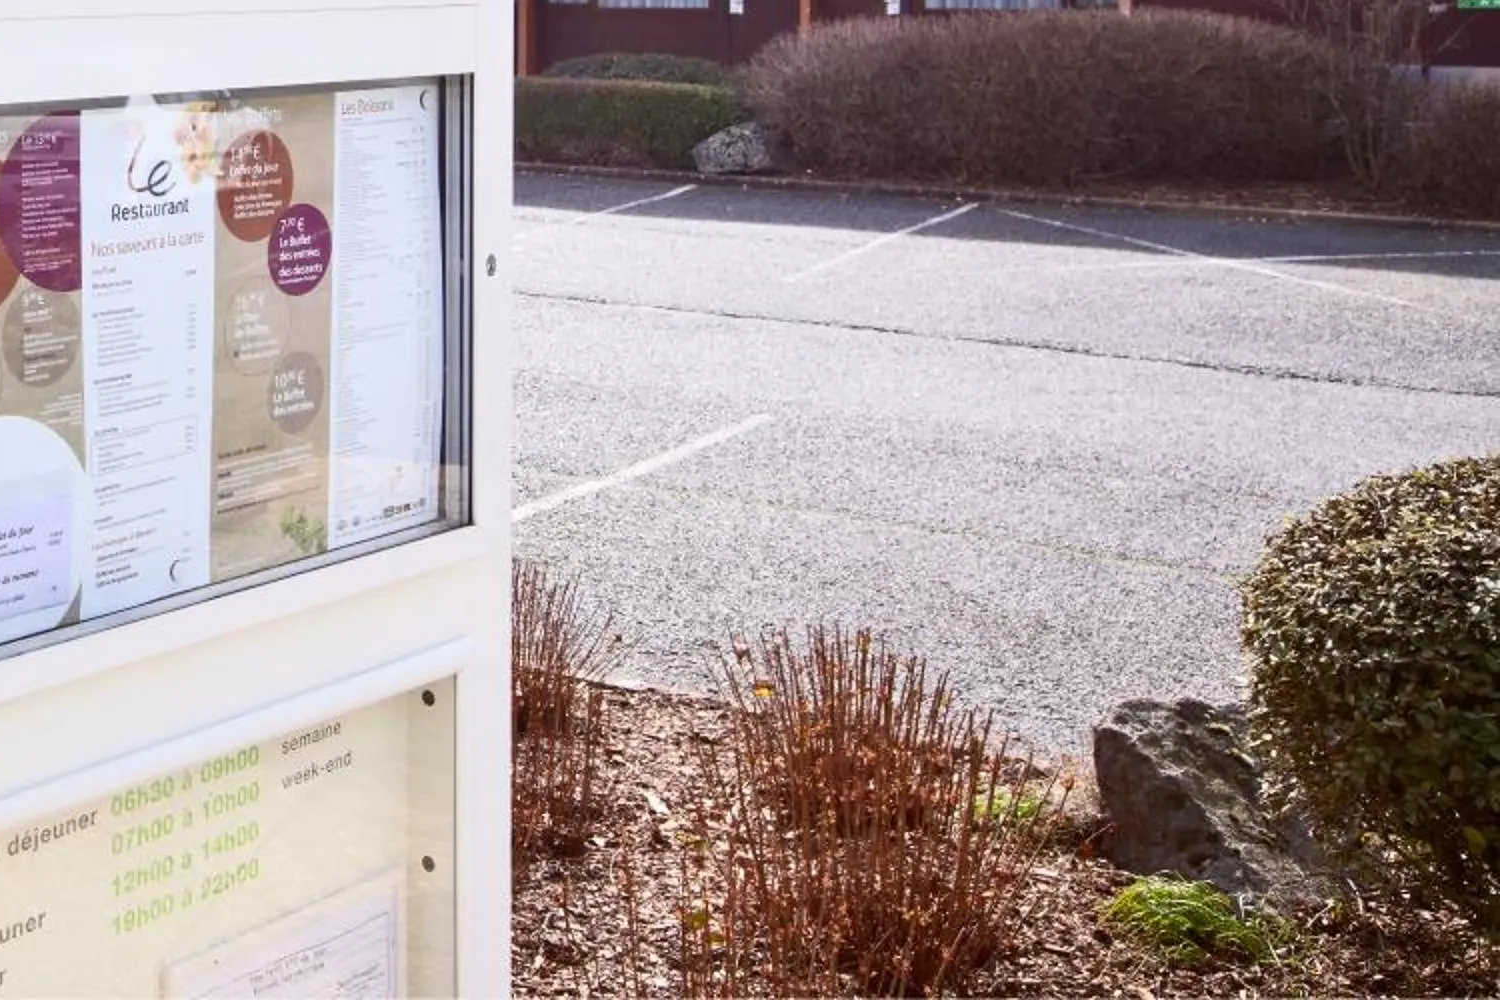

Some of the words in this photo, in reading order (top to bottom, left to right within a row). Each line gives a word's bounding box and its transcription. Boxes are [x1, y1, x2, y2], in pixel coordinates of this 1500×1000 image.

[111, 198, 189, 222] Restaurant
[178, 232, 205, 246] carte
[110, 776, 175, 817] 06h30
[181, 769, 193, 791] à
[200, 745, 259, 784] 09h00
[280, 721, 341, 755] semaine
[111, 813, 174, 855] 07h00
[201, 781, 260, 821] 10h00
[281, 751, 353, 790] week-end
[7, 808, 98, 857] déjeuner
[112, 855, 174, 897] 12h00
[201, 820, 260, 860] 14h00
[112, 893, 174, 935] 19h00
[200, 858, 260, 900] 22h00
